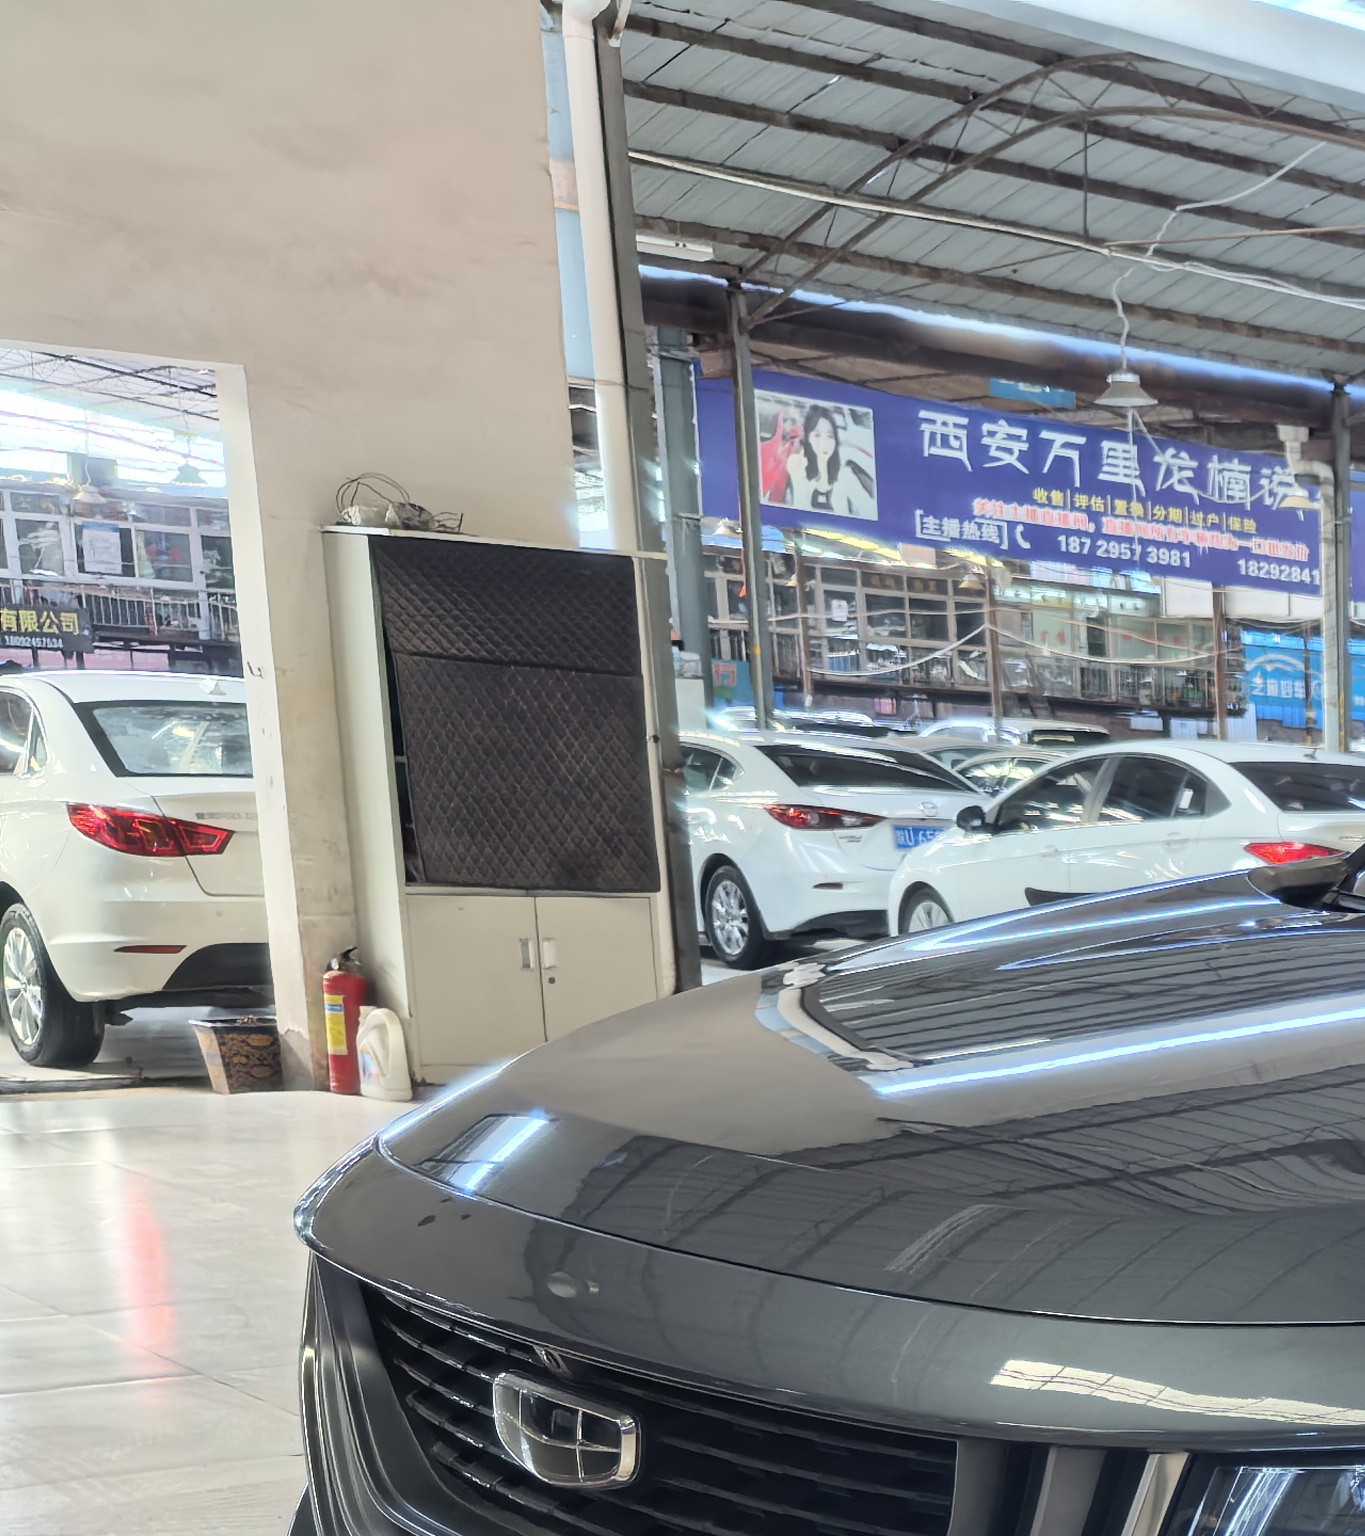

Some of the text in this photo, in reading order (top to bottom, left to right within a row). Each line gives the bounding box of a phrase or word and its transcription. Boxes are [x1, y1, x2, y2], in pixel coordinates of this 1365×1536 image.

[918, 409, 1321, 521] 西安万里龙楠说
[1057, 534, 1091, 555] 187
[1146, 546, 1192, 568] 3981
[0, 608, 79, 636] 有限公司
